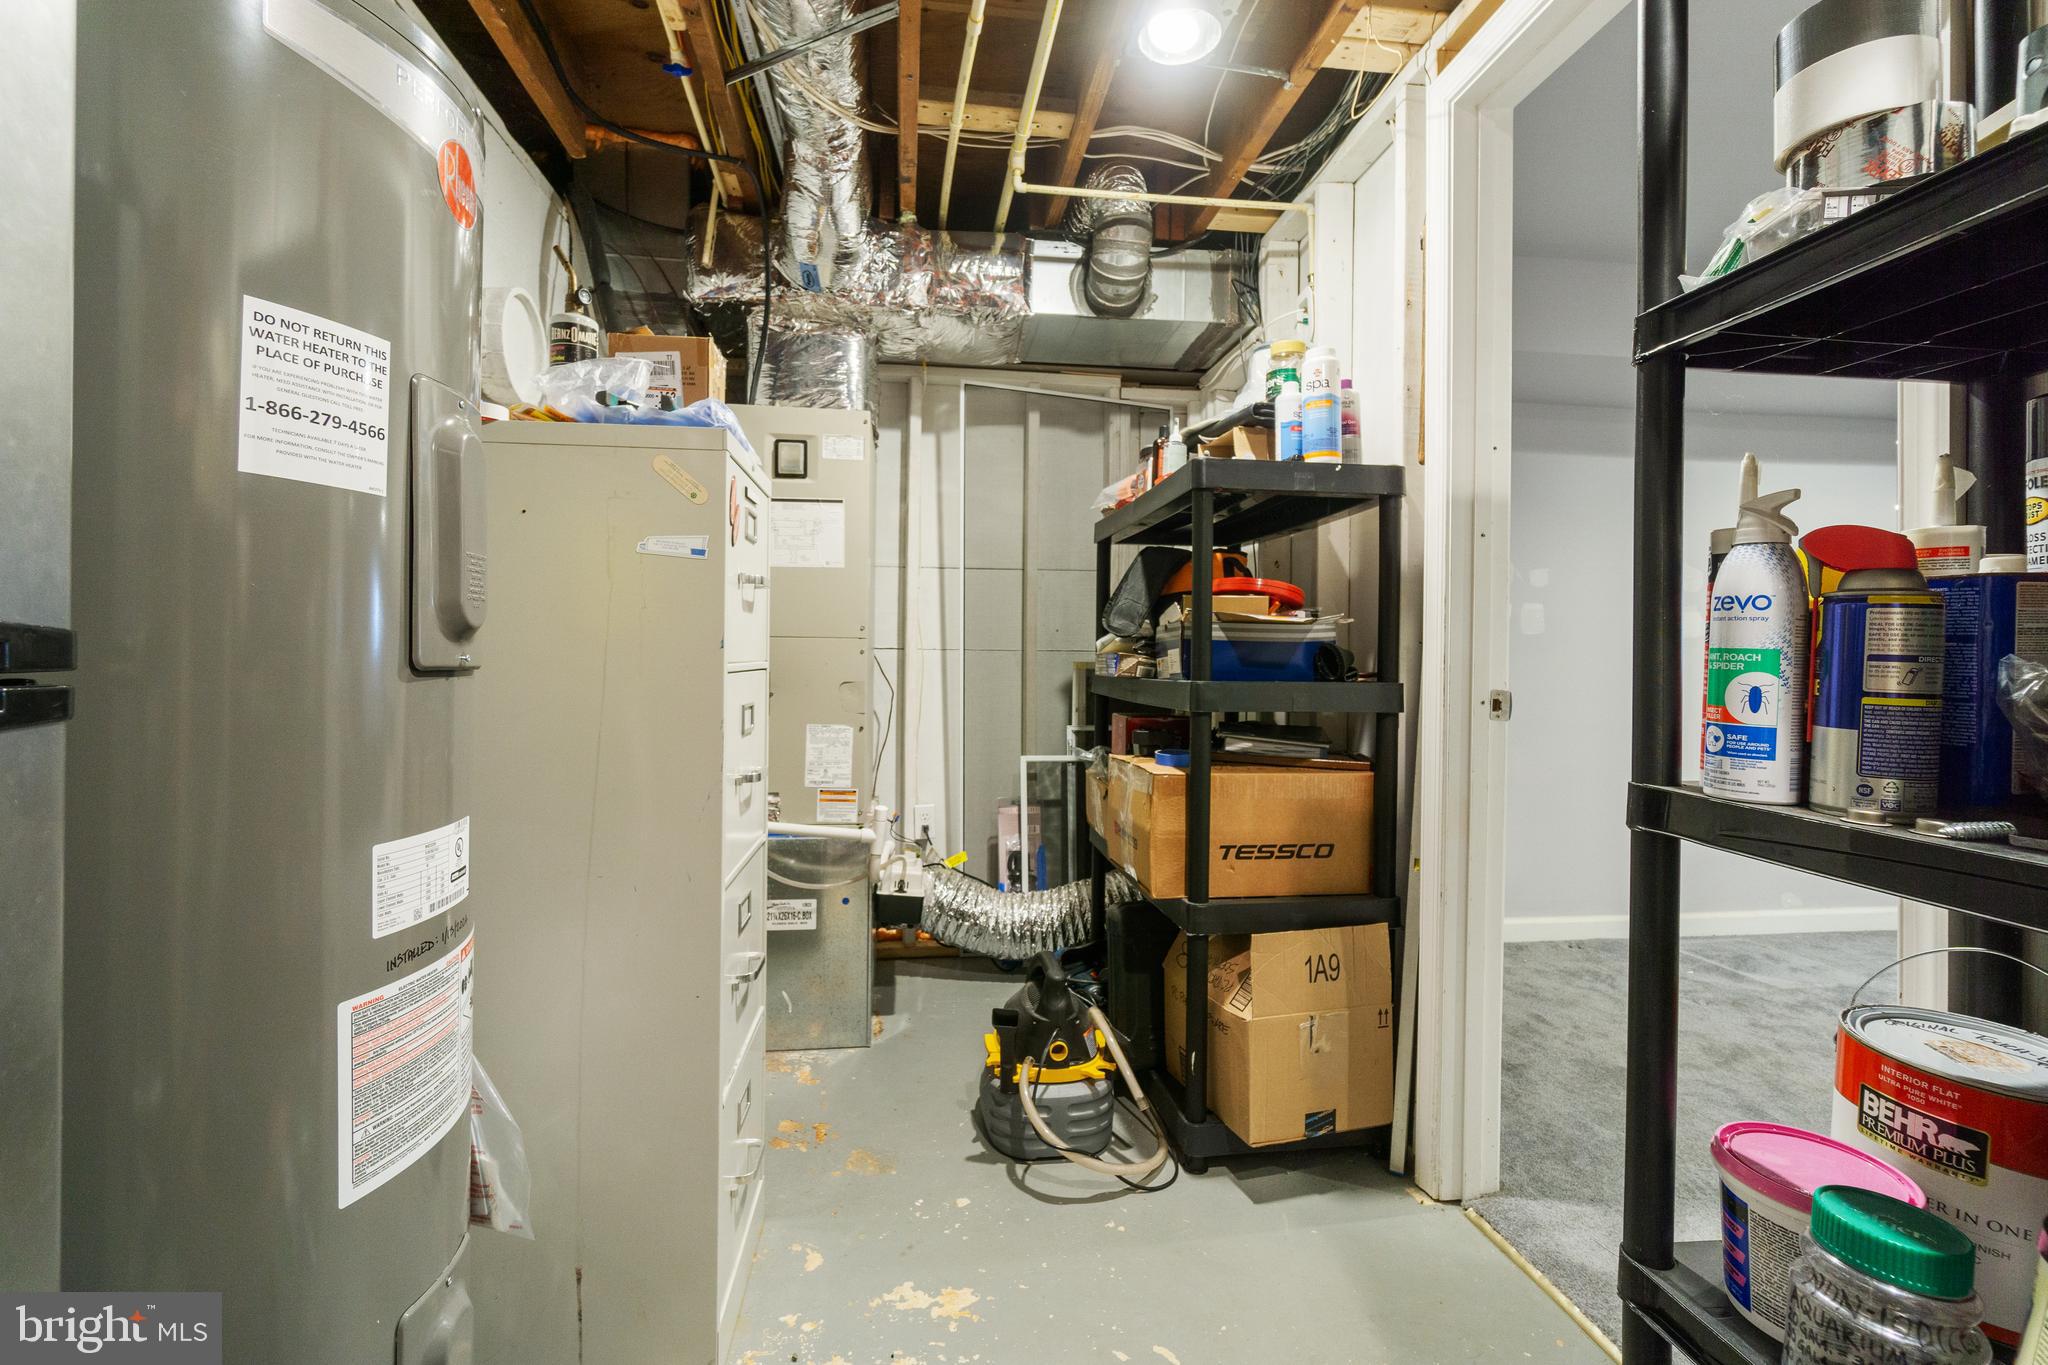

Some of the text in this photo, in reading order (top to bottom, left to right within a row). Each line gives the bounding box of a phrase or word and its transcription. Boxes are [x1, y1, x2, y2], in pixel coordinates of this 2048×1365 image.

[248, 325, 387, 376] WATER HEATER TO THE
[253, 311, 387, 361] DO NOT RETURN THIS
[256, 344, 383, 390] PLACE OF PURCHSE
[1306, 378, 1330, 393] spa
[244, 396, 386, 441] 1-866-279-4566
[1293, 410, 1302, 420] sp
[1713, 594, 1772, 613] zevo
[1712, 661, 1745, 671] SPIDER
[1723, 653, 1762, 662] ROACH
[1726, 733, 1748, 741] SAFE
[1219, 843, 1335, 860] TESSCO
[1304, 953, 1340, 984] 1A9
[352, 995, 384, 1011] WARNING
[1878, 1073, 1901, 1088] ULTRA
[1903, 1085, 1927, 1099] PURE
[1881, 1064, 1961, 1100] INTERIOR FLAT
[1863, 1089, 1939, 1146] BEHR
[1859, 1126, 1982, 1183] LIFETIME WARRANTY
[1861, 1113, 1976, 1173] PREMIUM PLUS
[1956, 1209, 1979, 1226] IN
[1986, 1220, 2033, 1242] ONE
